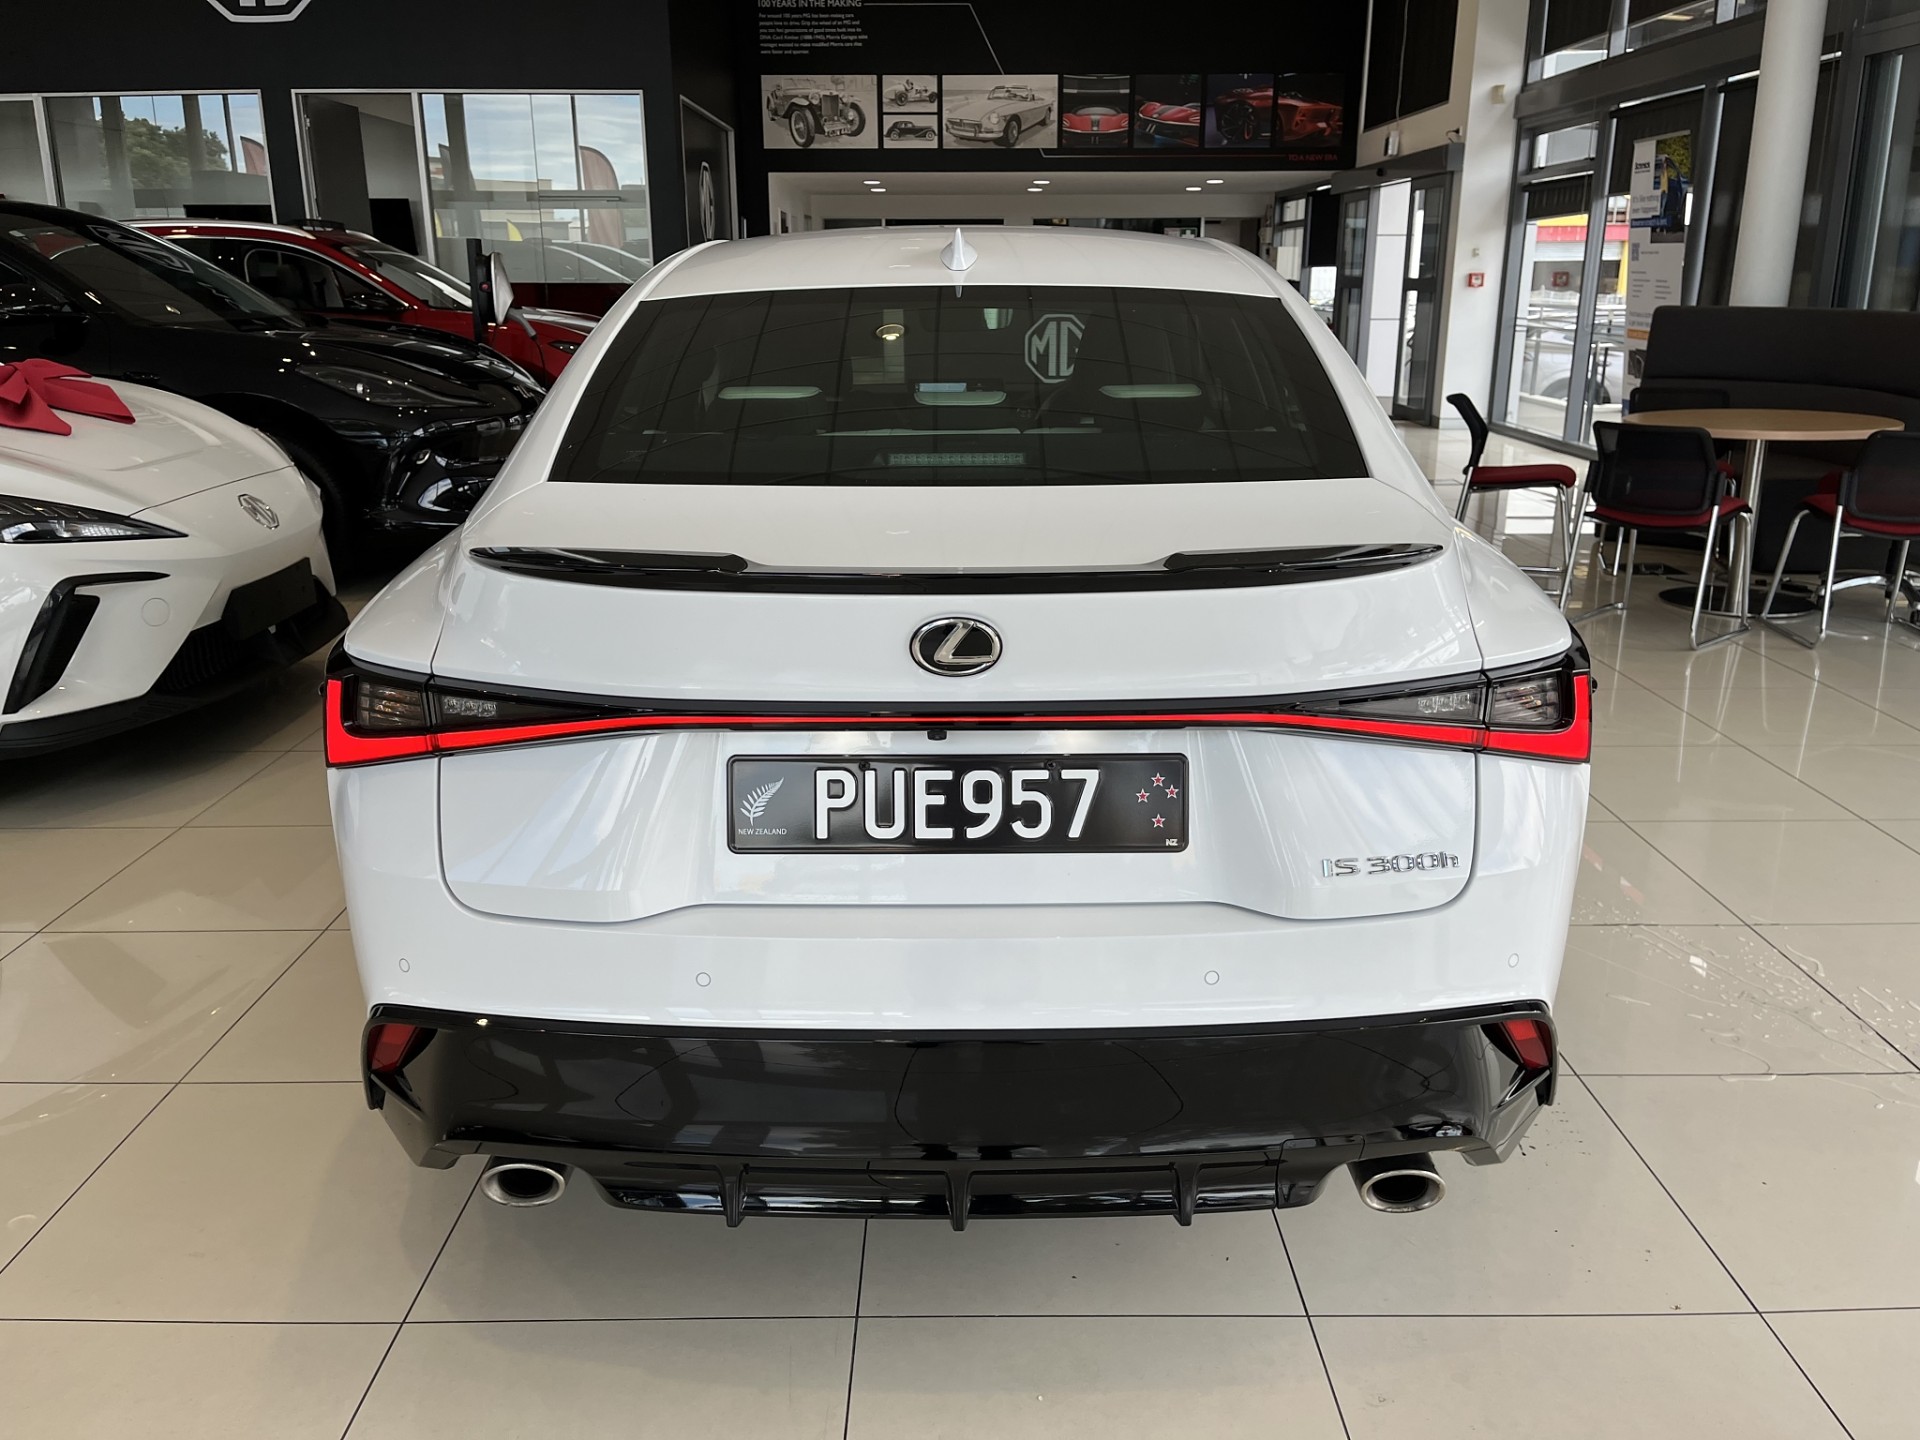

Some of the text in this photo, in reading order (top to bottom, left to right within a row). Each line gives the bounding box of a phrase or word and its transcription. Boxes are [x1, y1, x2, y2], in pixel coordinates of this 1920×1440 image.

[815, 768, 1100, 841] PUE957
[1165, 838, 1179, 847] NZ
[1322, 851, 1460, 878] IS 300h
